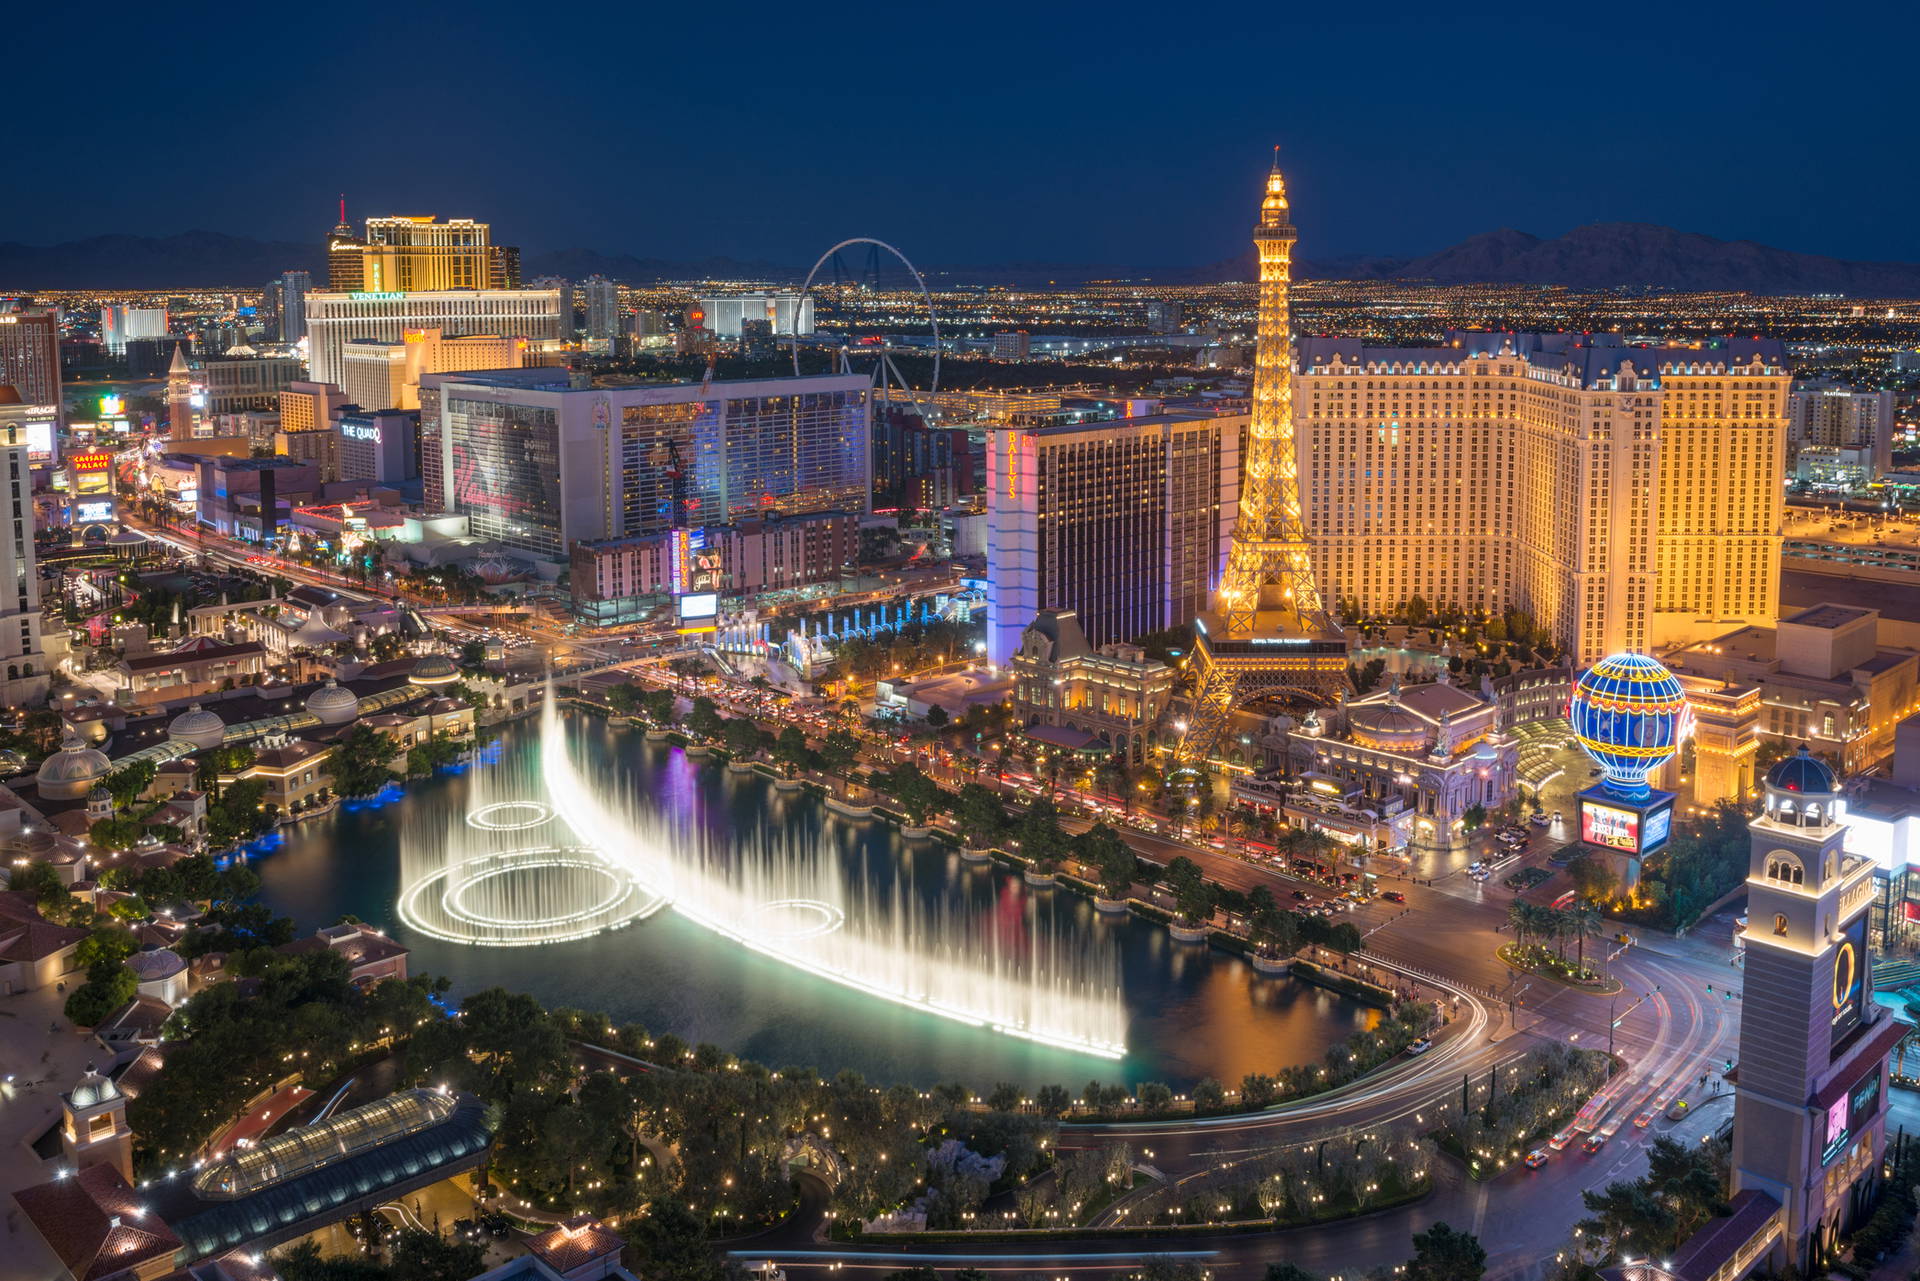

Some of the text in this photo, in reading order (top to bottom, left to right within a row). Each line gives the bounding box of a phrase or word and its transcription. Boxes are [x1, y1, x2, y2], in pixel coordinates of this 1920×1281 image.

[351, 292, 403, 300] VENETIAN
[342, 424, 356, 437] THE
[75, 454, 109, 462] CAESARS
[76, 461, 108, 469] PALACE
[1853, 1074, 1880, 1116] FENDI
